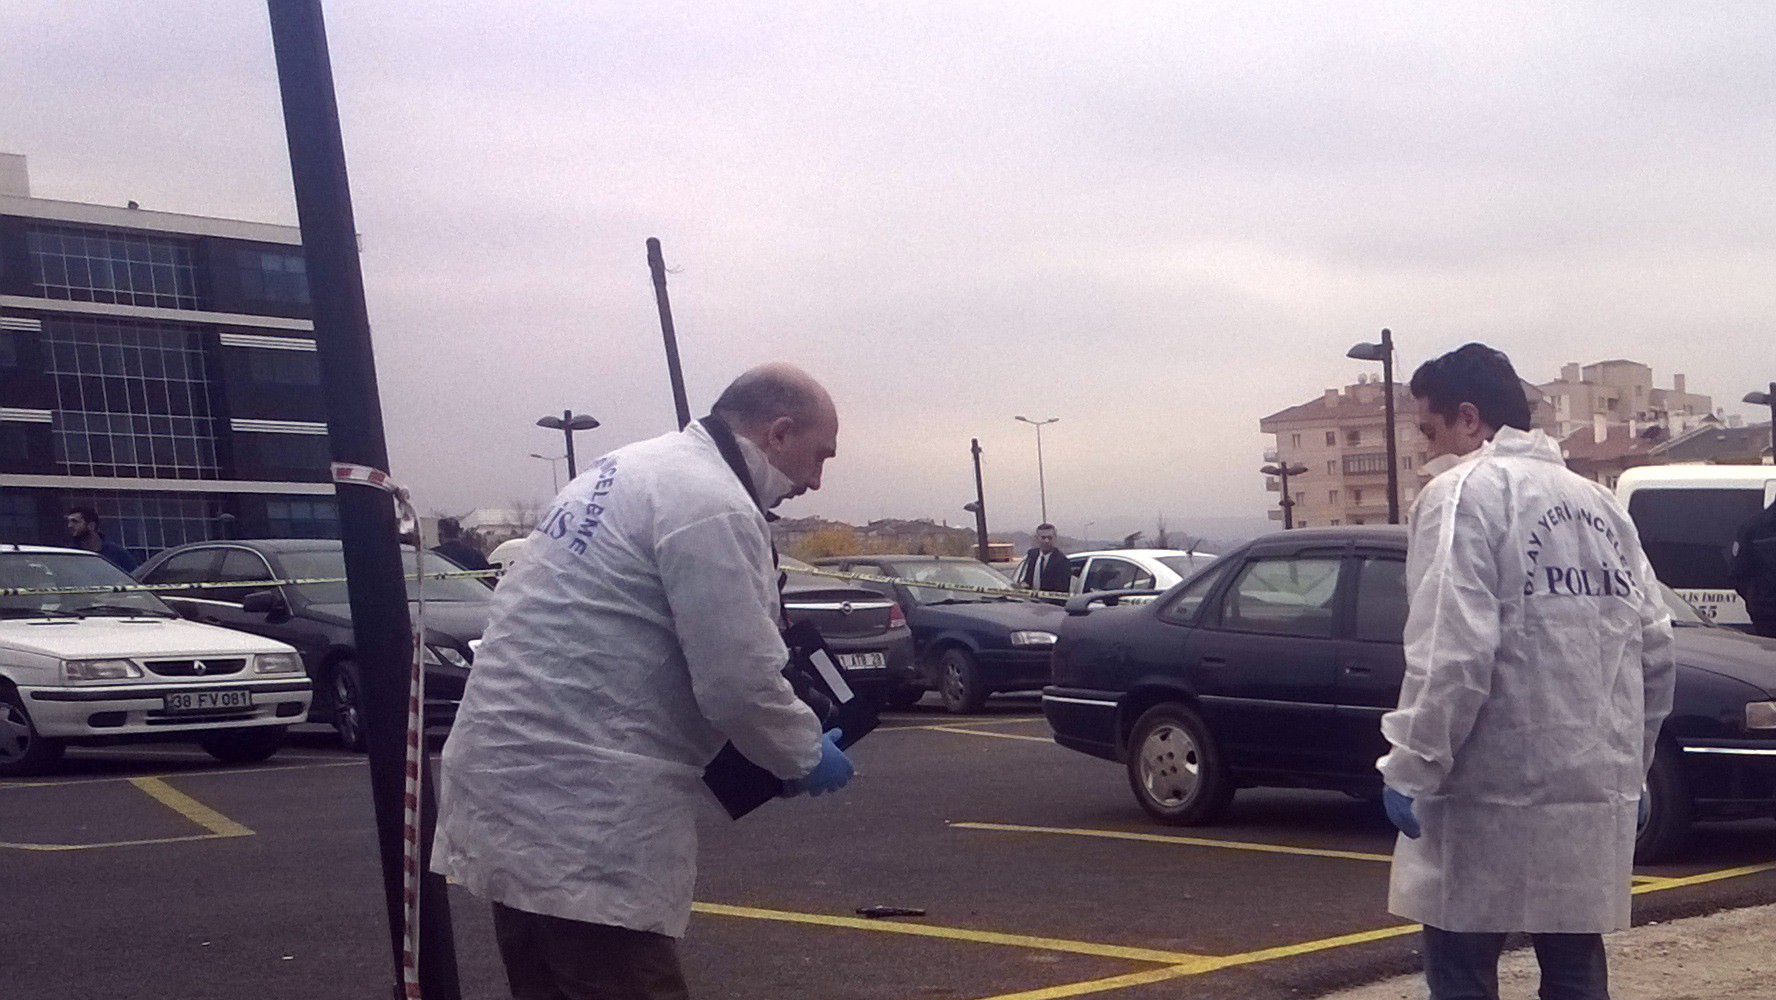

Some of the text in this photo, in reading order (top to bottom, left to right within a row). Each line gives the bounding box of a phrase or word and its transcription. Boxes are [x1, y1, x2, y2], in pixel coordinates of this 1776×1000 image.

[1545, 562, 1631, 598] POLİS
[173, 694, 192, 709] 38
[198, 692, 219, 708] FV
